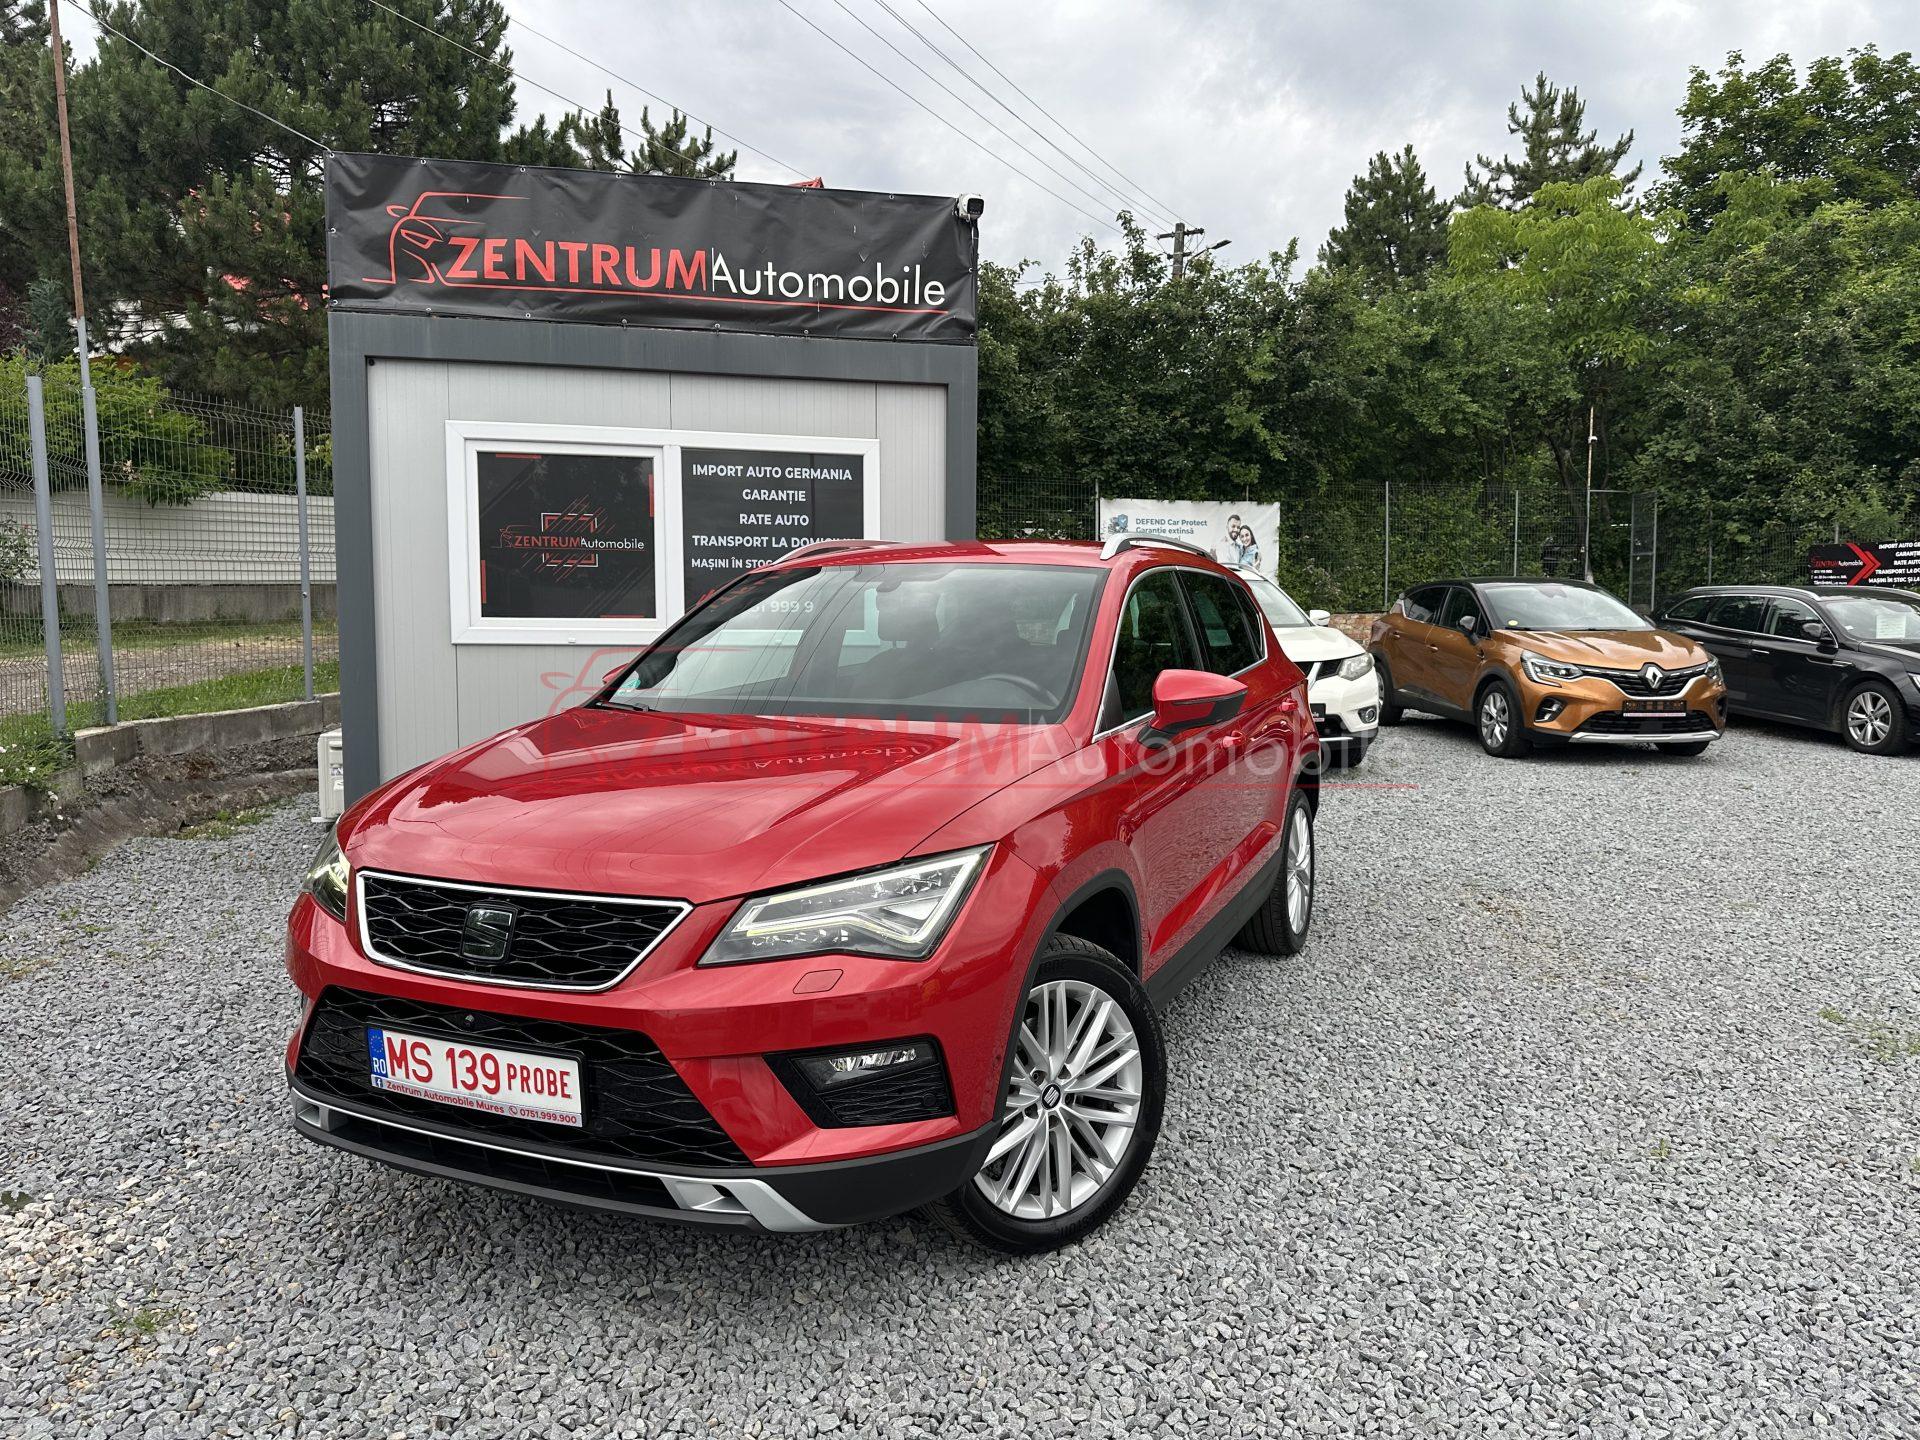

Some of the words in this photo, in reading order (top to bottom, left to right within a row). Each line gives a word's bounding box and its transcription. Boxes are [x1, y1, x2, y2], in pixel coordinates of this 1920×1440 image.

[445, 237, 706, 291] ZENTRUM
[711, 250, 946, 306] Automobile
[692, 464, 743, 477] IMPORT
[746, 466, 782, 479] AUTO
[785, 468, 853, 481] GERMANIA
[742, 489, 806, 504] GARANȚIE
[739, 513, 772, 525] RATE
[775, 515, 809, 526] AUTO
[1135, 518, 1166, 526] DEFEND
[1181, 519, 1208, 527] Protect
[514, 535, 580, 547] ZENTRUM
[580, 537, 645, 550] Automobile
[692, 535, 769, 548] TRANSPORT
[772, 536, 788, 548] LA
[691, 558, 729, 571] MAȘINI
[731, 556, 743, 569] ÎN
[373, 1057, 386, 1074] RO
[386, 1037, 433, 1083] MS
[445, 1047, 501, 1095] 139
[507, 1063, 572, 1098] PROBE
[386, 1080, 422, 1096] Zentrum
[423, 1090, 475, 1107] Automobile
[476, 1100, 505, 1113] Mures
[520, 1108, 577, 1124] 0751.999.900
